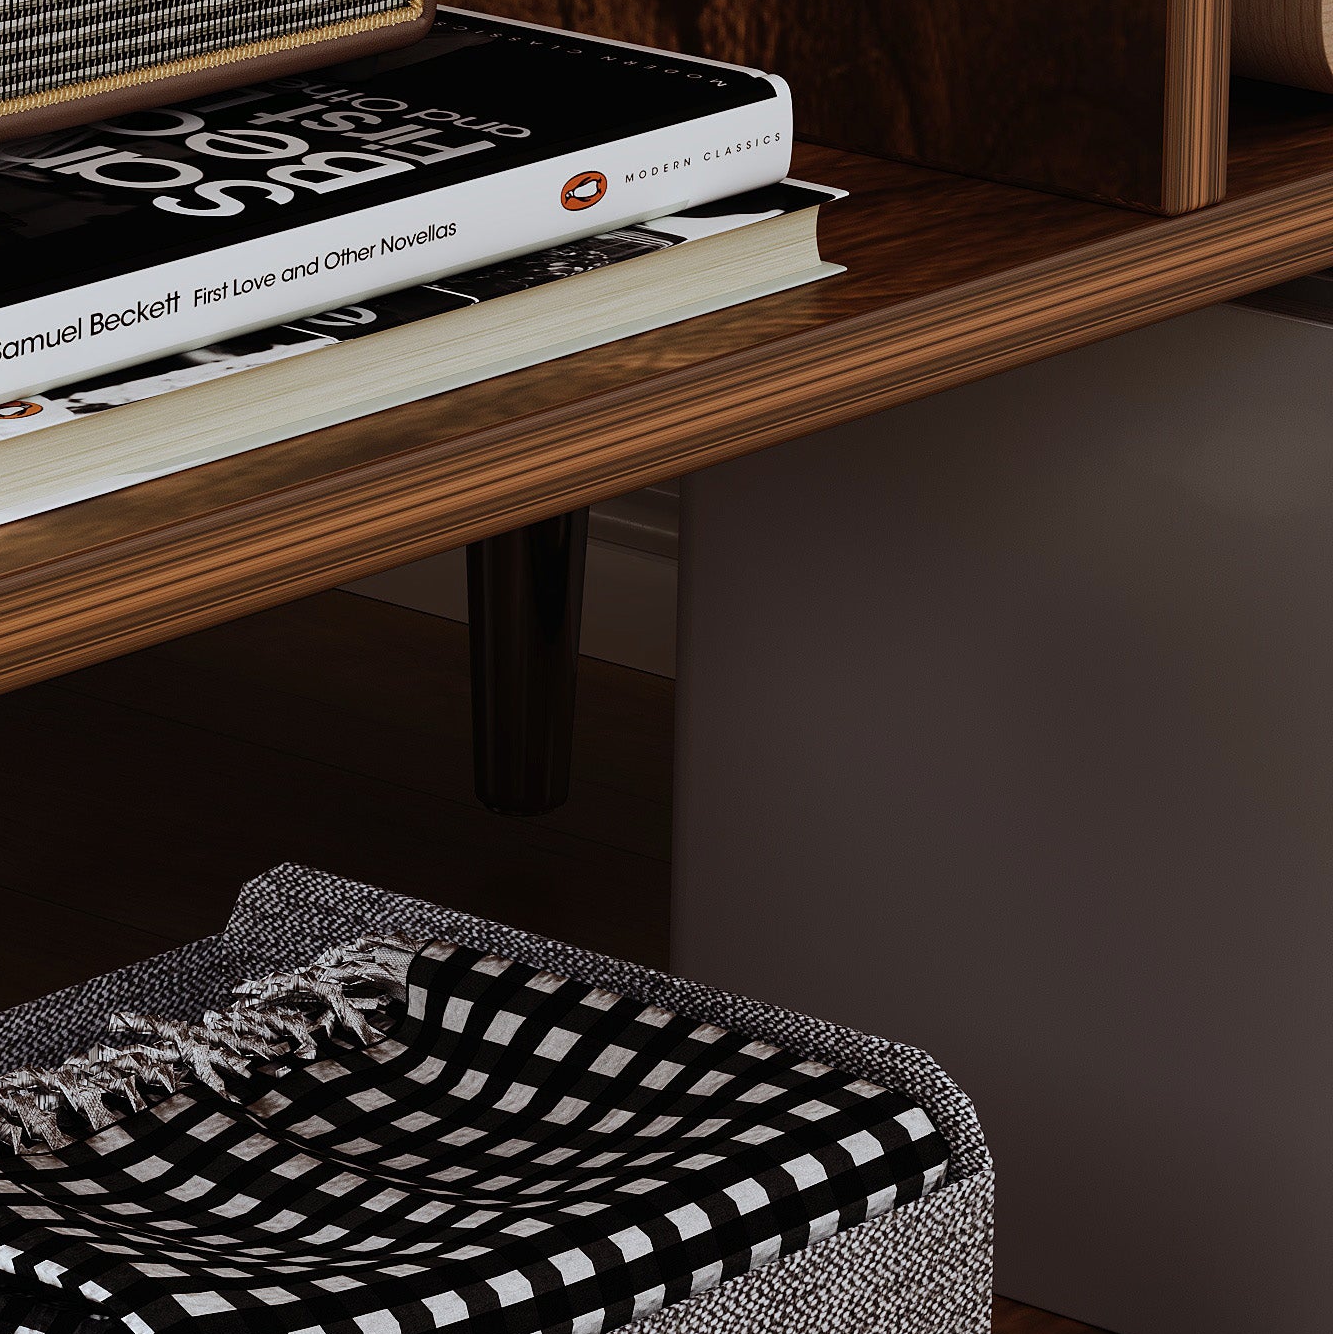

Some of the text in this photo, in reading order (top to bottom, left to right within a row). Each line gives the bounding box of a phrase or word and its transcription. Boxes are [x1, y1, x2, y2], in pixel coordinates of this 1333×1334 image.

[599, 55, 728, 87] MODERN
[269, 77, 409, 112] Othe
[247, 104, 497, 165] First
[402, 108, 531, 138] and
[625, 132, 781, 183] MODERN CLASSICS
[90, 291, 181, 336] Beckett
[194, 282, 229, 307] First
[233, 272, 276, 296] Love
[281, 257, 319, 282] and
[324, 244, 376, 270] Other
[381, 222, 457, 255] Novellas
